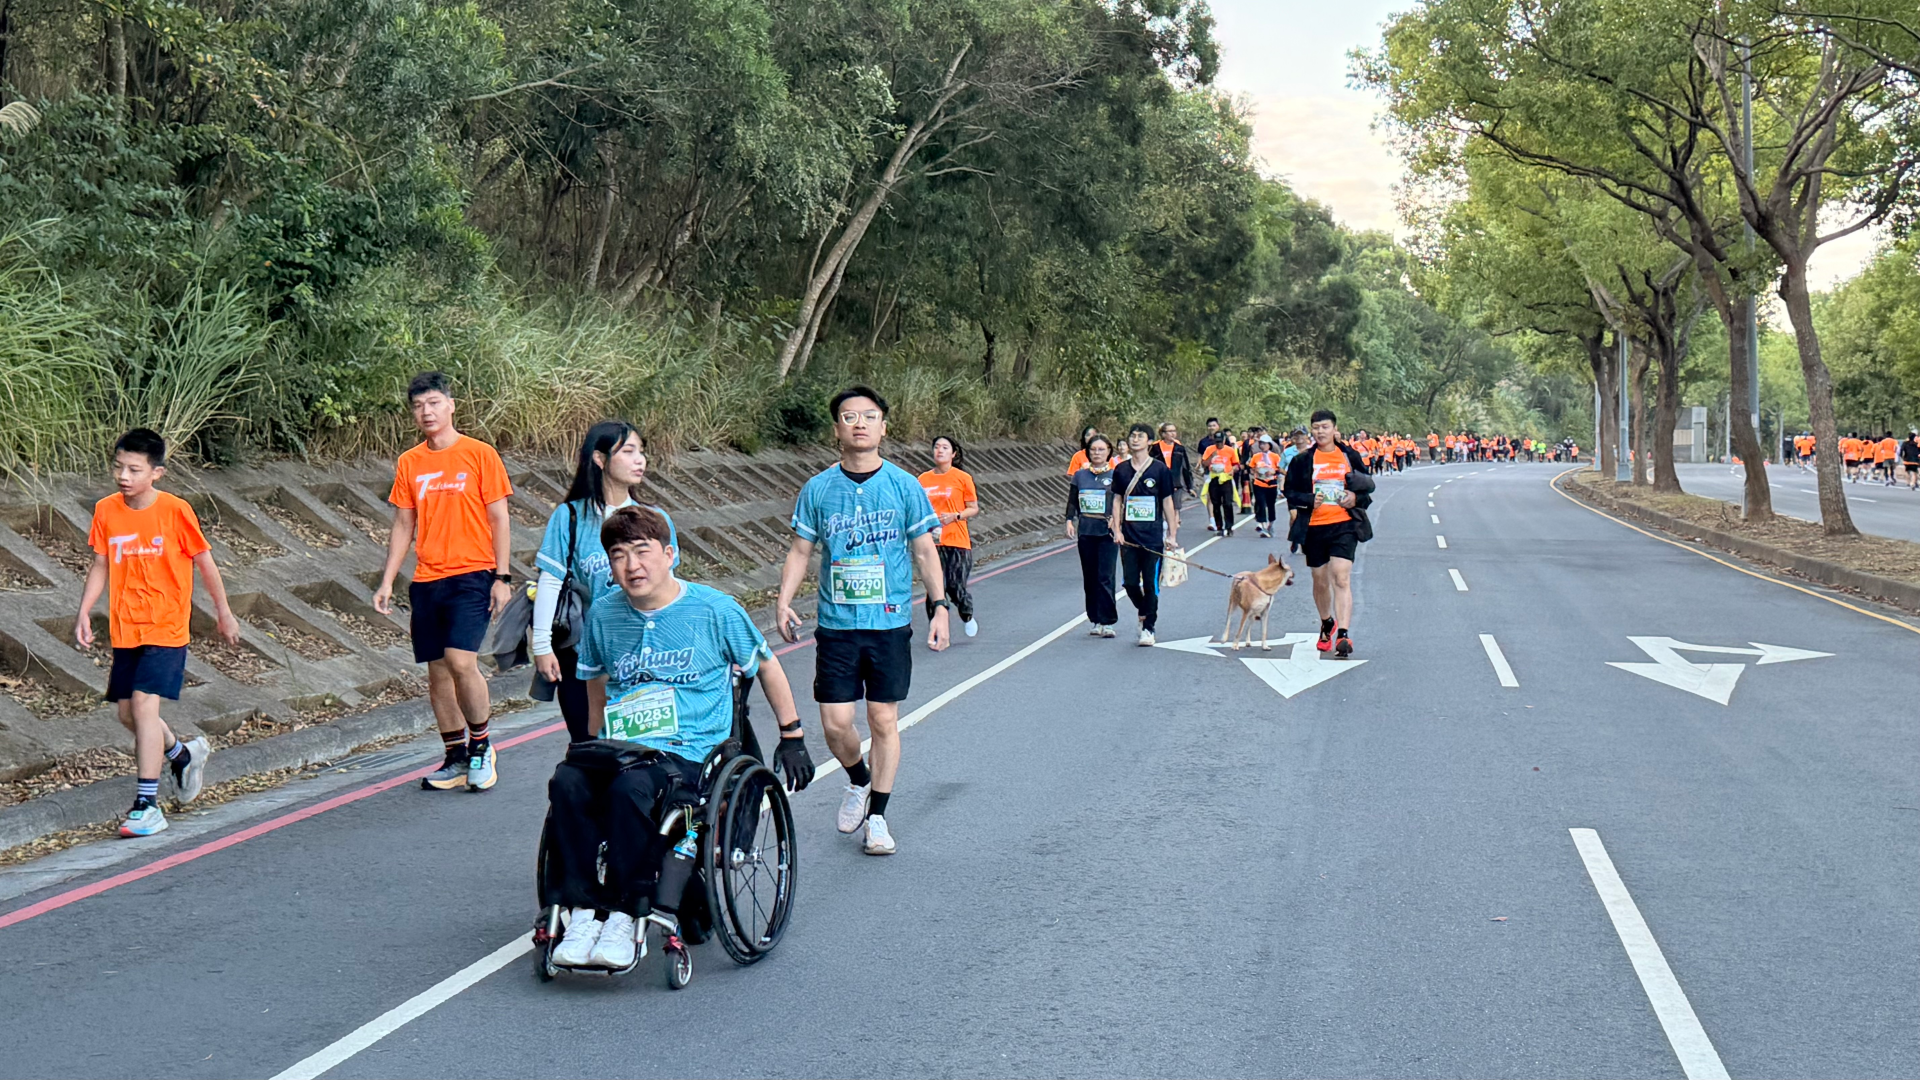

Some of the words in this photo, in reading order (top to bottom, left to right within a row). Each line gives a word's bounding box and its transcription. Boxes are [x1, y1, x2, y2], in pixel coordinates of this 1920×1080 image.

[822, 509, 895, 539] Taichung
[844, 528, 899, 553] Daegu
[845, 579, 881, 591] 70290
[613, 647, 694, 680] Taihung
[612, 718, 624, 733] 男
[626, 706, 672, 728] 70283
